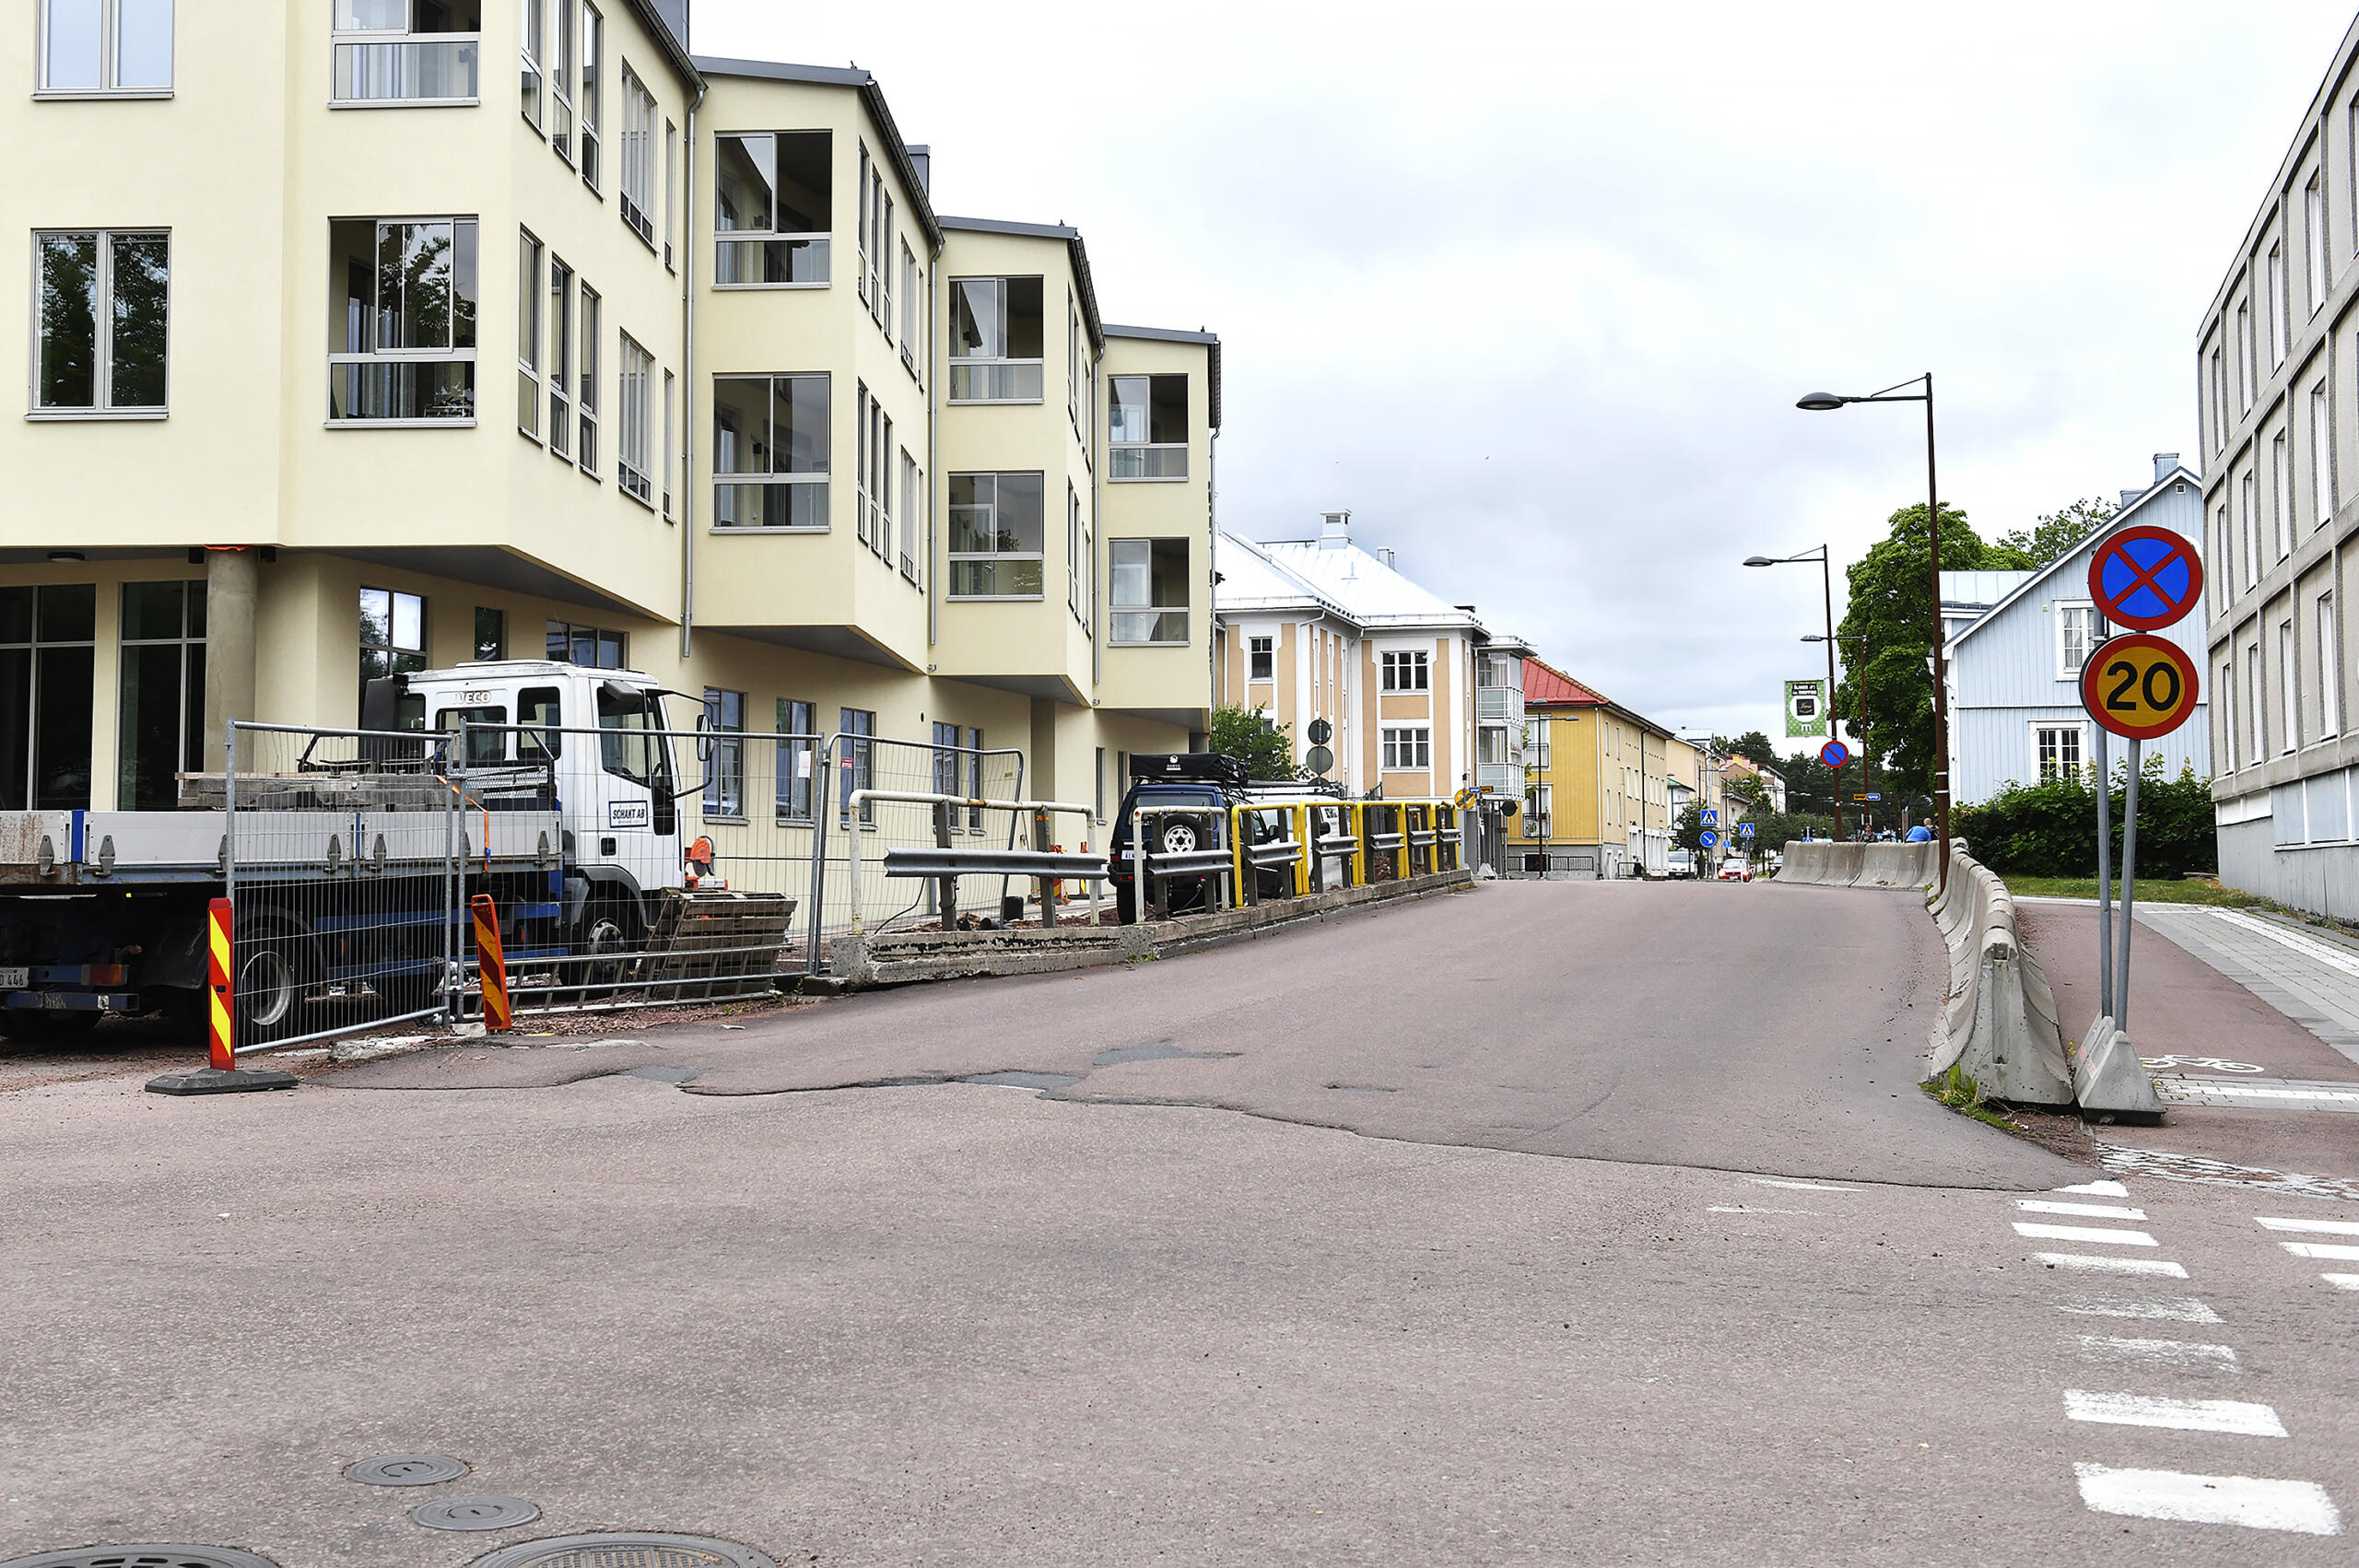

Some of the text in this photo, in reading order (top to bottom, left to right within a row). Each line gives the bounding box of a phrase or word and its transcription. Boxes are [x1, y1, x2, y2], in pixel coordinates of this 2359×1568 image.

[2106, 661, 2180, 711] 20
[452, 690, 492, 704] IVECO
[636, 808, 645, 819] AB
